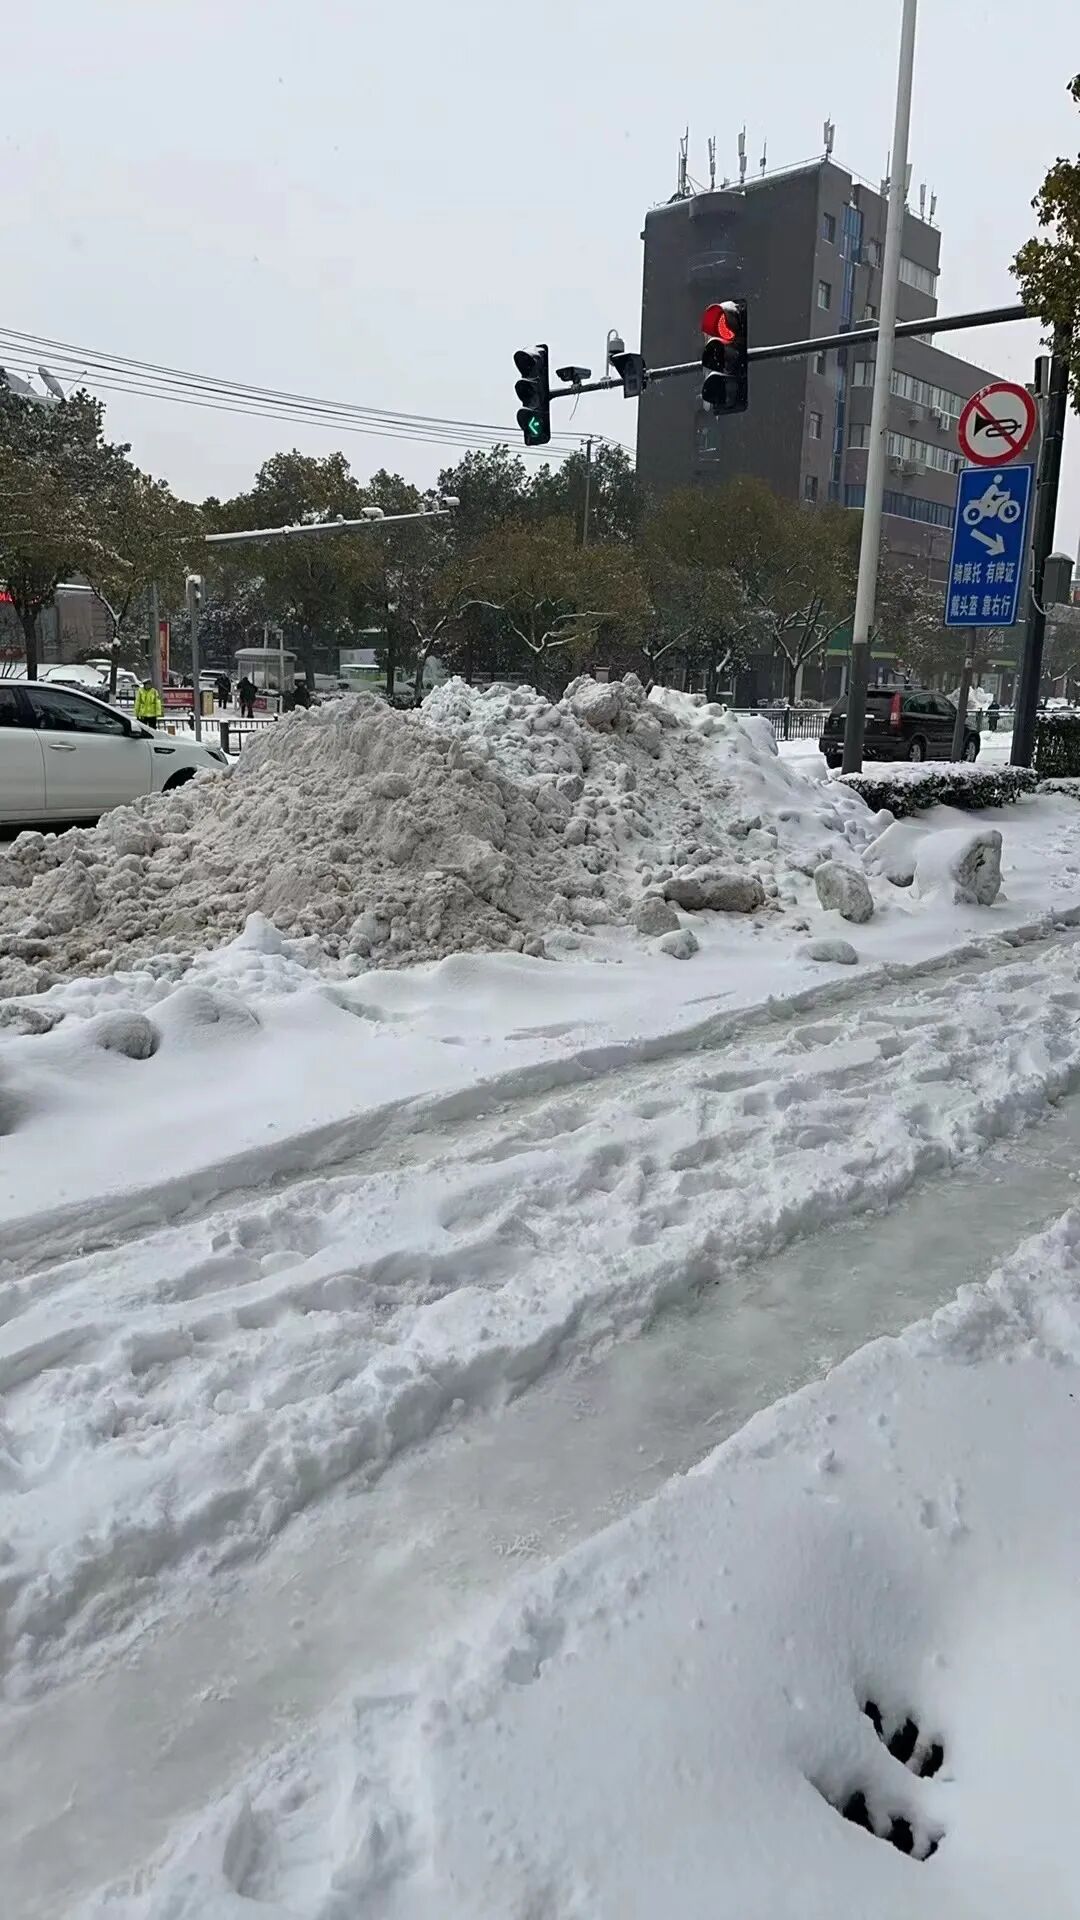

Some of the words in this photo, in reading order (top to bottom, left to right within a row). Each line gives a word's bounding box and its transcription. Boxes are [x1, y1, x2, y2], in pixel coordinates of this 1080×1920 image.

[953, 562, 982, 584] 骑摩托
[986, 561, 1015, 584] 有牌证
[950, 594, 979, 617] 戴头盔
[982, 594, 1011, 617] 靠右行
